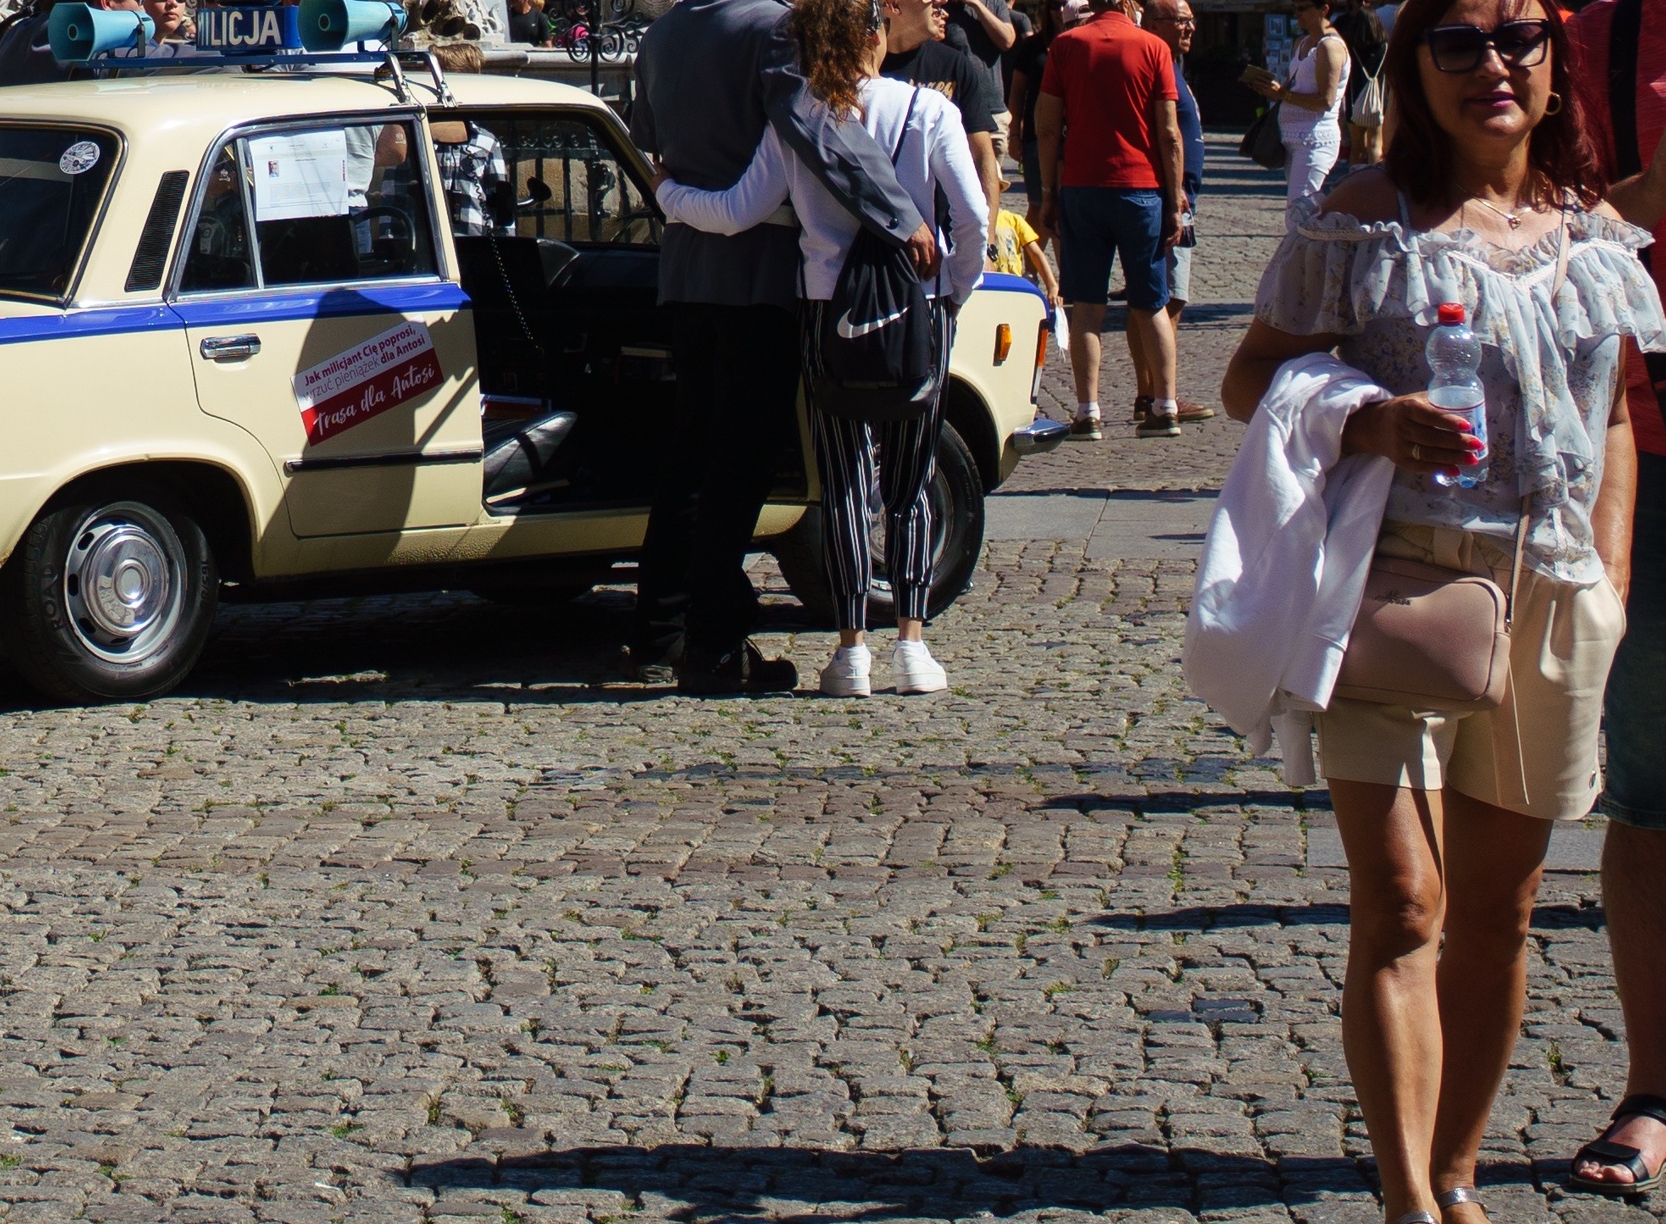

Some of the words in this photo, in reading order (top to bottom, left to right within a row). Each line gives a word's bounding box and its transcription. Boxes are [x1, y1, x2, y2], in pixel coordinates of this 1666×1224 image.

[303, 379, 335, 402] wrzuć
[334, 356, 381, 390] pieniążek
[380, 351, 395, 365] dla
[397, 334, 426, 358] Antosi
[304, 373, 323, 387] Jak
[322, 350, 363, 378] milicjant
[363, 344, 379, 358] Cię
[379, 325, 416, 354] poprosi,
[361, 384, 386, 412] dla
[391, 363, 436, 400] Antosi
